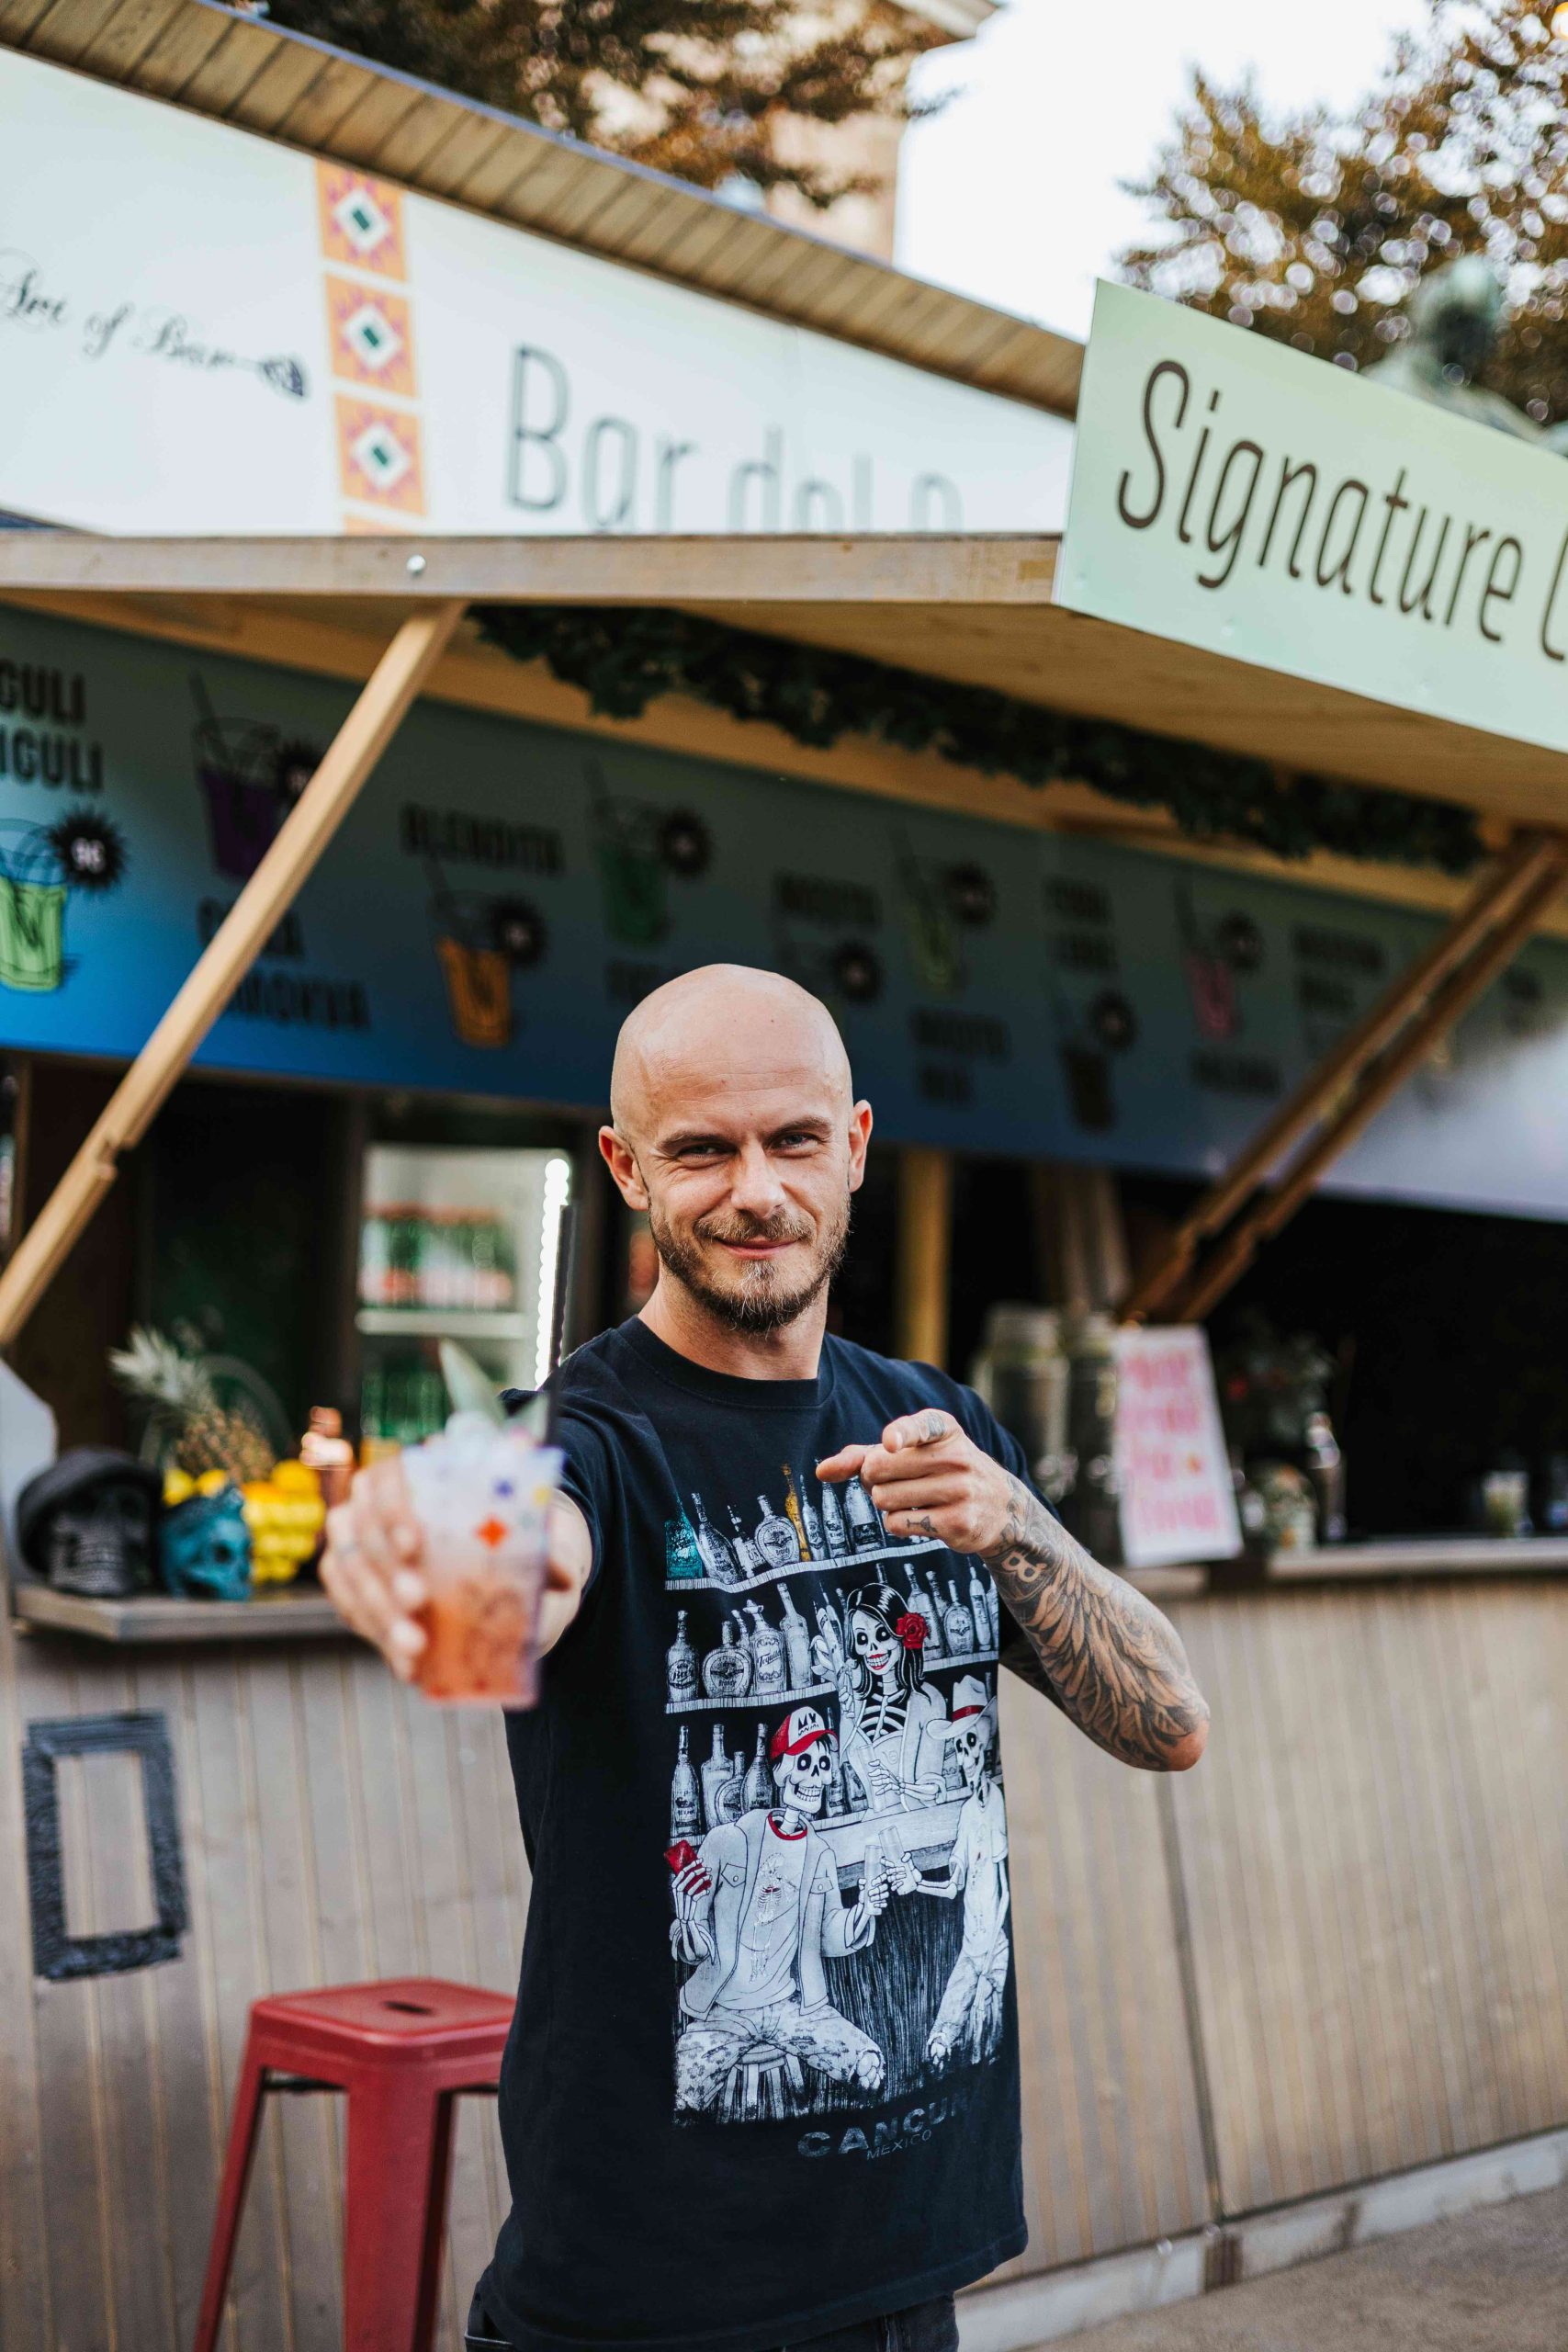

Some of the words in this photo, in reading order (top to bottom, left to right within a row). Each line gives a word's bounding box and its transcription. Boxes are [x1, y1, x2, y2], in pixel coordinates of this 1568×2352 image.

[507, 344, 698, 533] Bar
[1118, 359, 1523, 642] Signature
[867, 2128, 933, 2161] MEXICO
